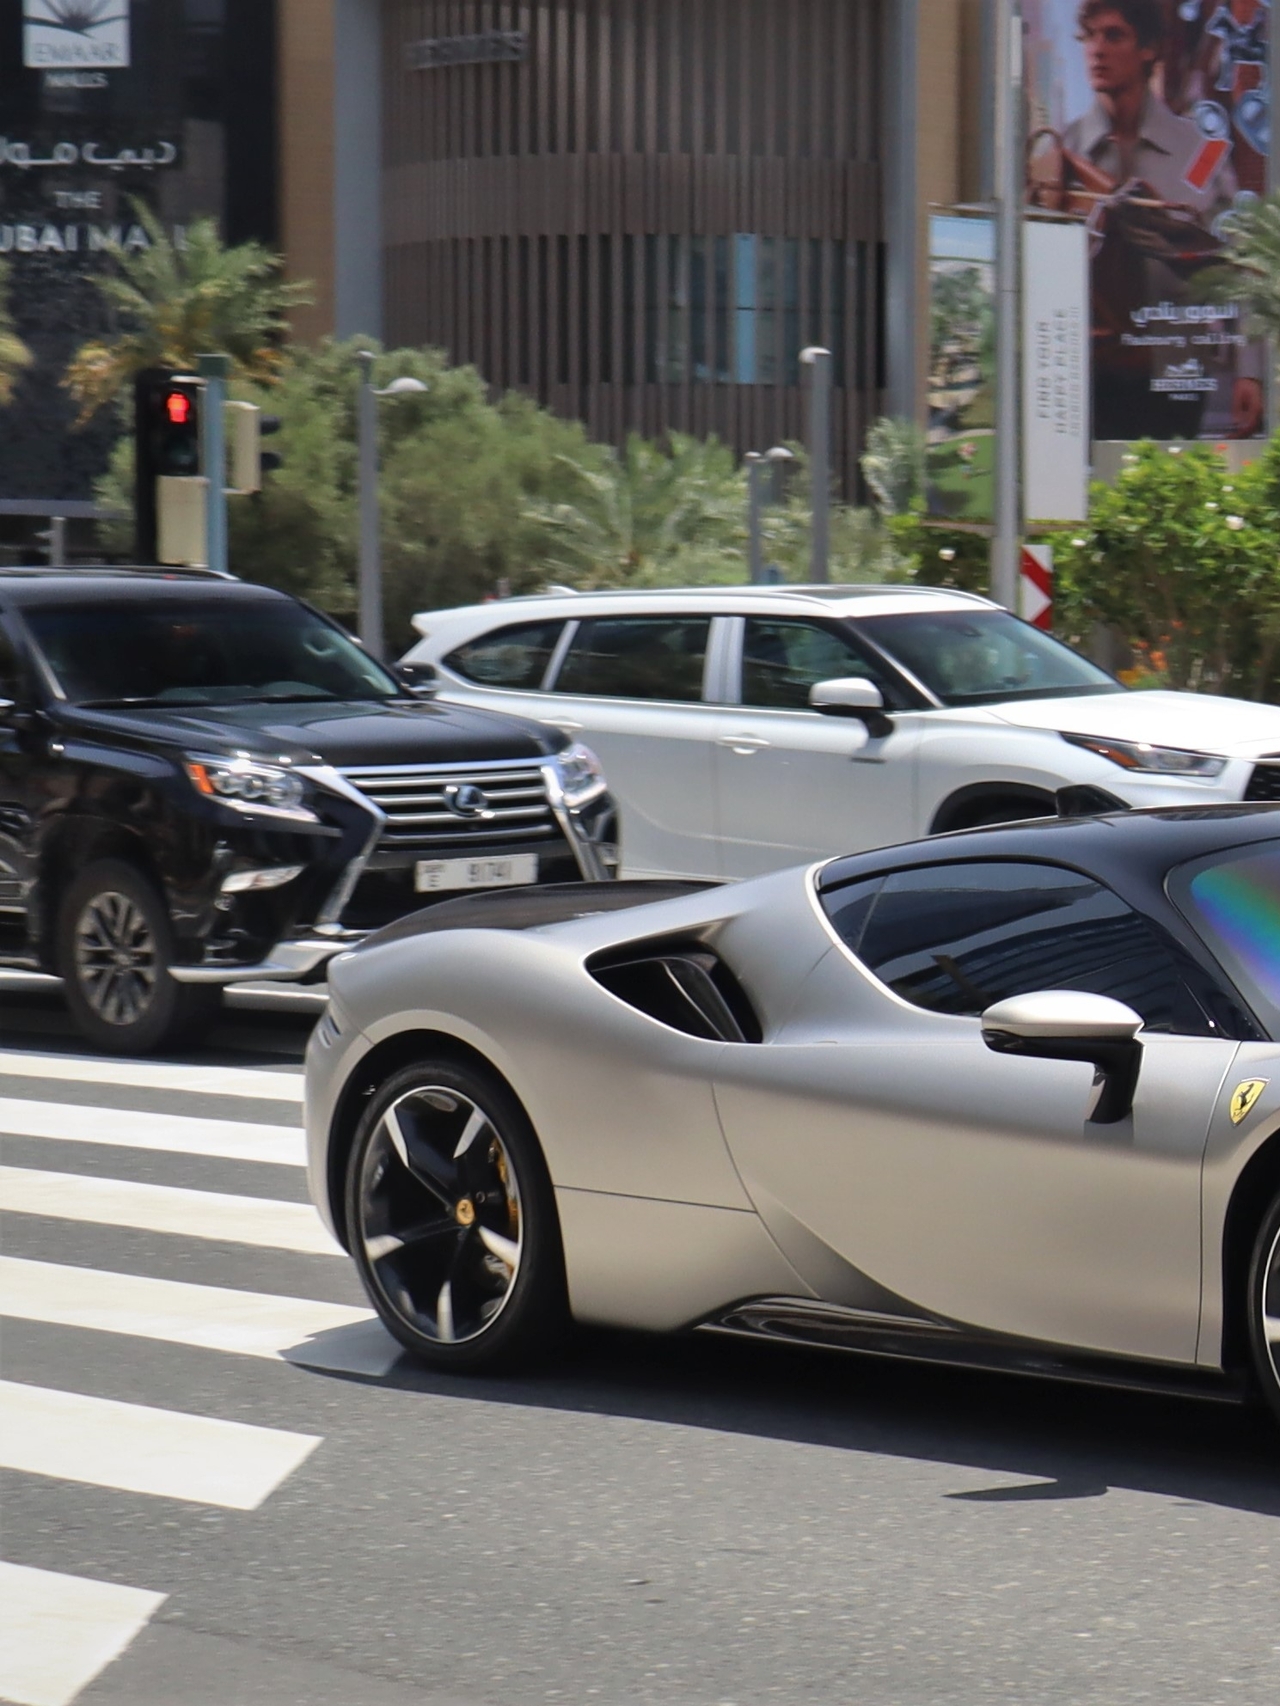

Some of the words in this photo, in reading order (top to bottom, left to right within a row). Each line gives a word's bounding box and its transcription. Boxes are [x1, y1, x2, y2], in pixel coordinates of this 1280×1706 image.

[1036, 321, 1051, 370] YOUR
[1052, 308, 1067, 367] PLACE
[1036, 377, 1051, 419] FIND
[1053, 375, 1067, 434] HAPPY
